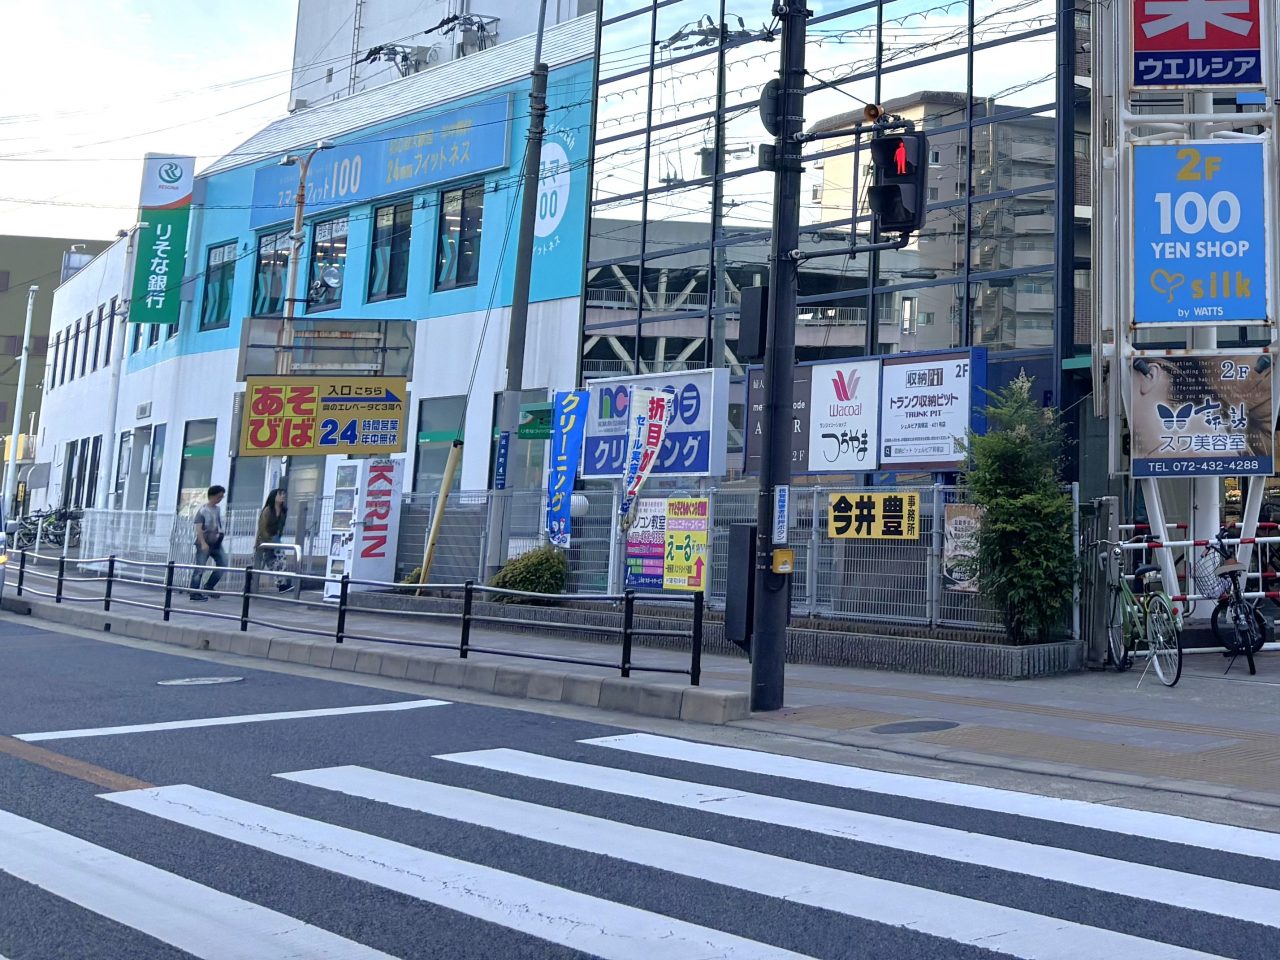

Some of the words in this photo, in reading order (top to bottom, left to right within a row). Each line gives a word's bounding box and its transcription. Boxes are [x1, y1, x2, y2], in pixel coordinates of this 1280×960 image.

[1138, 56, 1256, 81] ウエルシア
[1176, 148, 1223, 182] 2F
[1154, 190, 1241, 235] 100
[1151, 242, 1191, 259] YEN
[1196, 240, 1250, 257] SHOP
[146, 224, 172, 309] りそな銀行
[1191, 271, 1252, 299] silk
[1178, 308, 1190, 318] by
[1194, 306, 1224, 316] WATTS
[955, 363, 969, 378] 2F
[1220, 360, 1249, 381] 2F
[251, 386, 317, 417] あそ
[328, 385, 352, 396] 入口
[355, 387, 382, 396] こちら
[890, 392, 959, 410] トランク収納ピット
[829, 402, 863, 418] Wacoal
[904, 410, 929, 419] TRUNK
[929, 409, 943, 417] PIT
[248, 418, 316, 448] びば
[319, 418, 359, 446] 24
[361, 419, 400, 432] 時間営業
[1159, 434, 1246, 452] スワ美容室
[594, 436, 702, 471] クリング
[821, 428, 869, 463] つちやま
[1148, 462, 1169, 472] TEL
[1173, 460, 1259, 471] 072-432-4288
[360, 465, 394, 559] KIRIN
